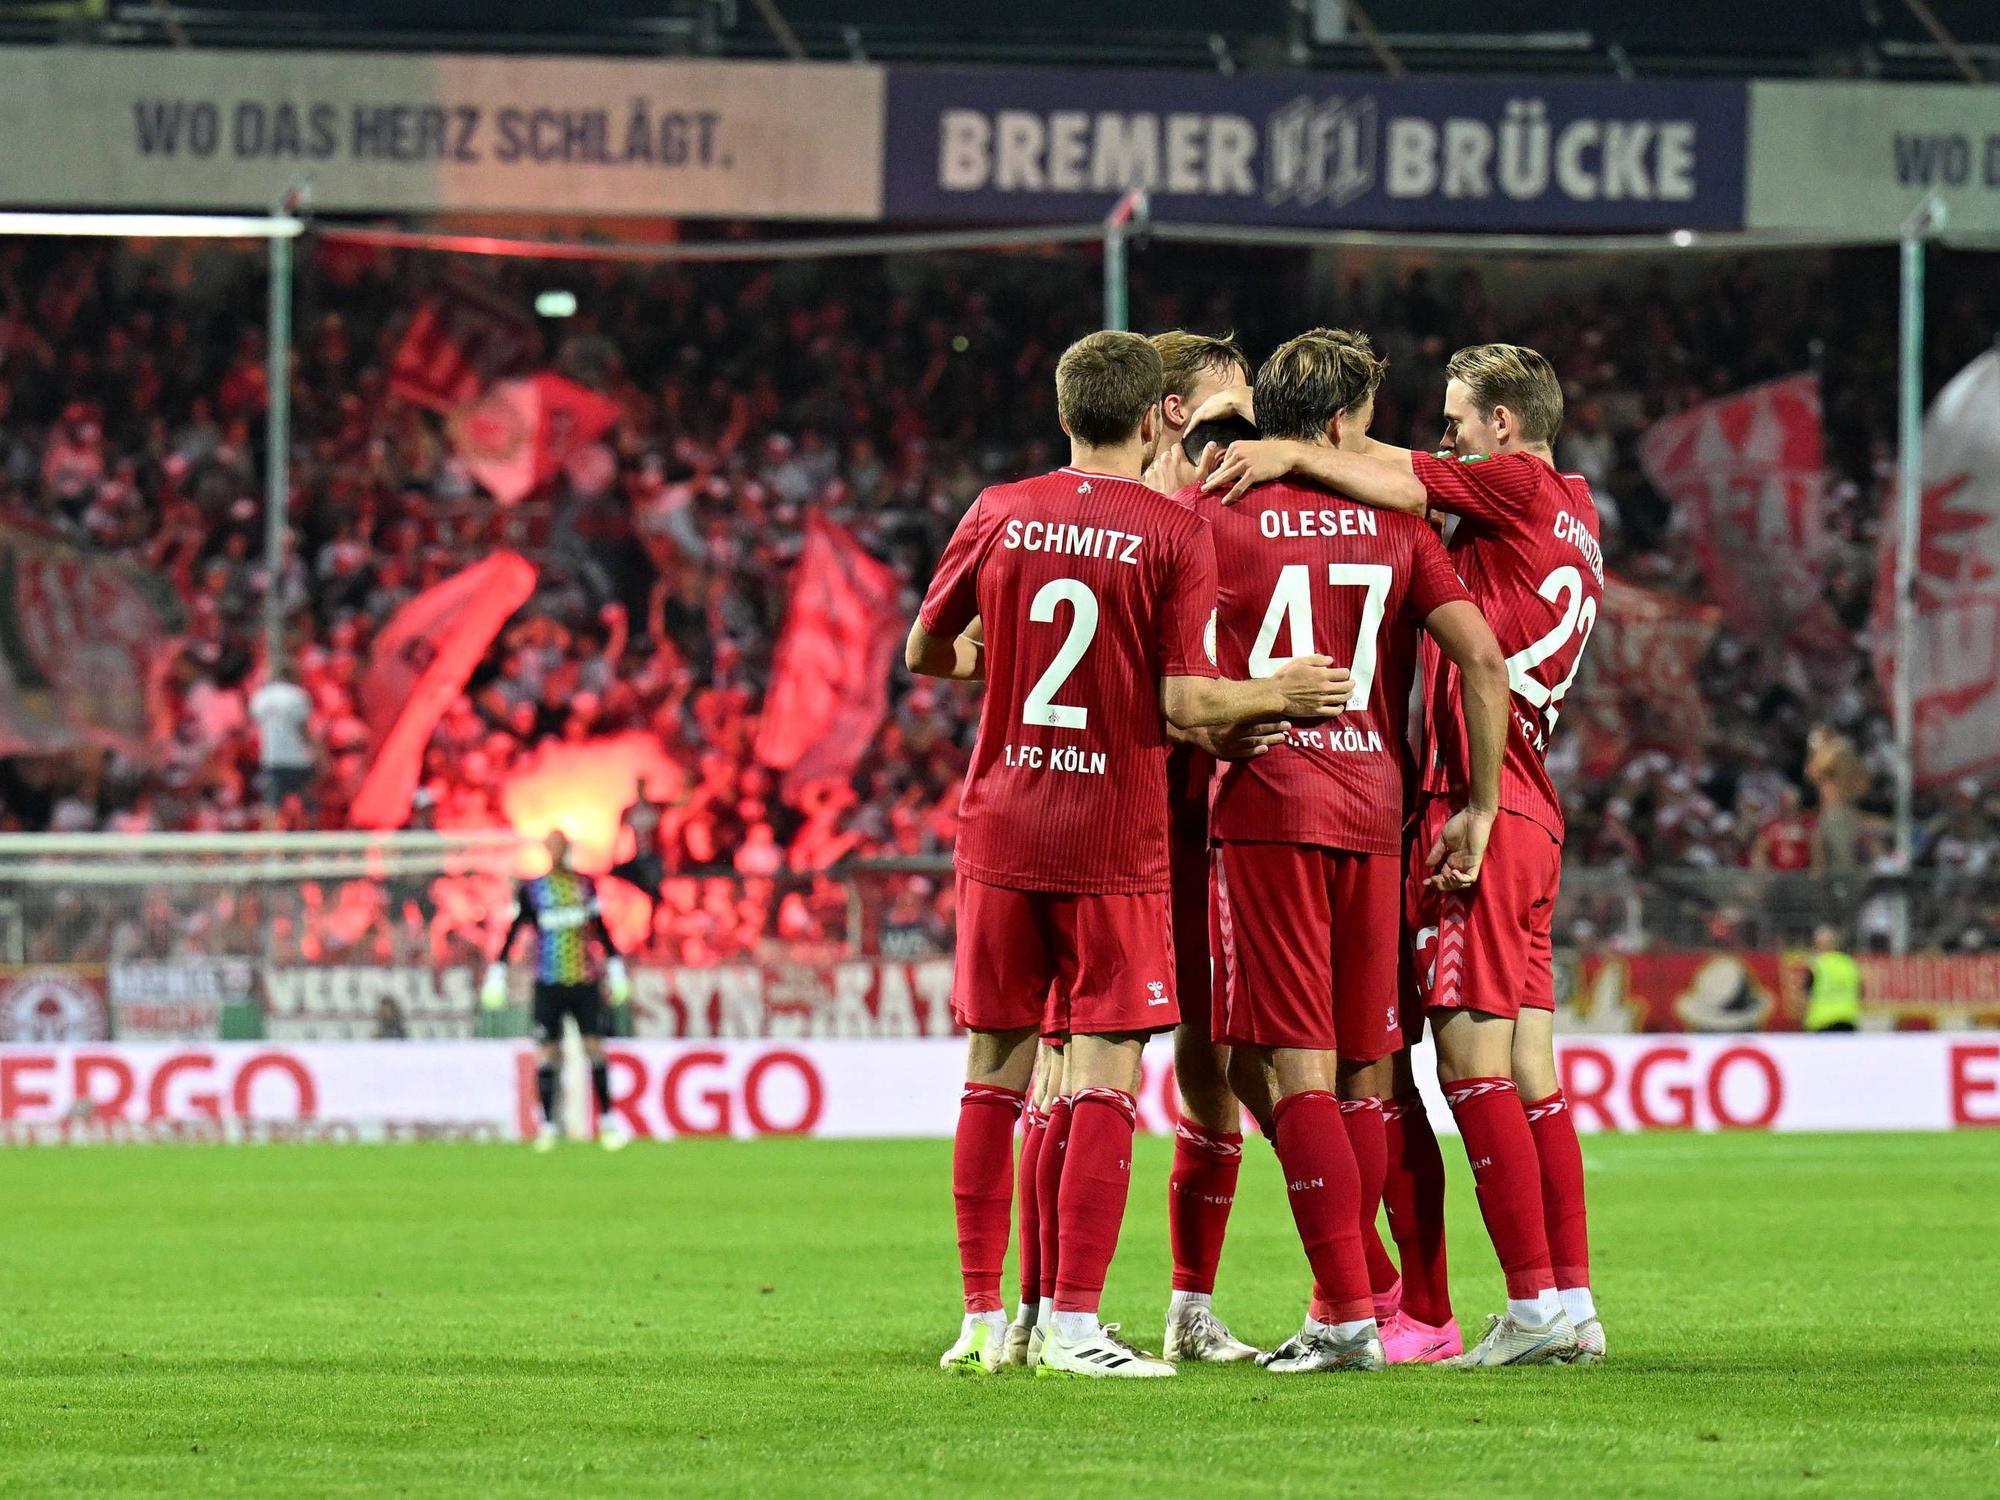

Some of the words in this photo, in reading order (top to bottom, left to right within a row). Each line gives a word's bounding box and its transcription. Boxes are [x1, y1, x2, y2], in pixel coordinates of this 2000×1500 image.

[134, 100, 220, 157] WO
[234, 102, 338, 160] DAS
[355, 104, 480, 163] HERZ
[939, 109, 1257, 194] BREMER
[1386, 99, 1696, 199] BRÜCKE
[1895, 133, 1970, 187] WO
[1003, 519, 1143, 565] SCHMITZ
[1260, 509, 1377, 538] OLESEN
[1023, 578, 1099, 730] 2
[1249, 563, 1393, 711] 47
[1504, 566, 1597, 735] 22
[1005, 744, 1043, 769] 1.FC
[1049, 745, 1107, 775] KÖLN
[1330, 727, 1383, 752] KÖLN
[0, 1053, 315, 1138] ERGO
[1561, 1048, 1782, 1129] RGO
